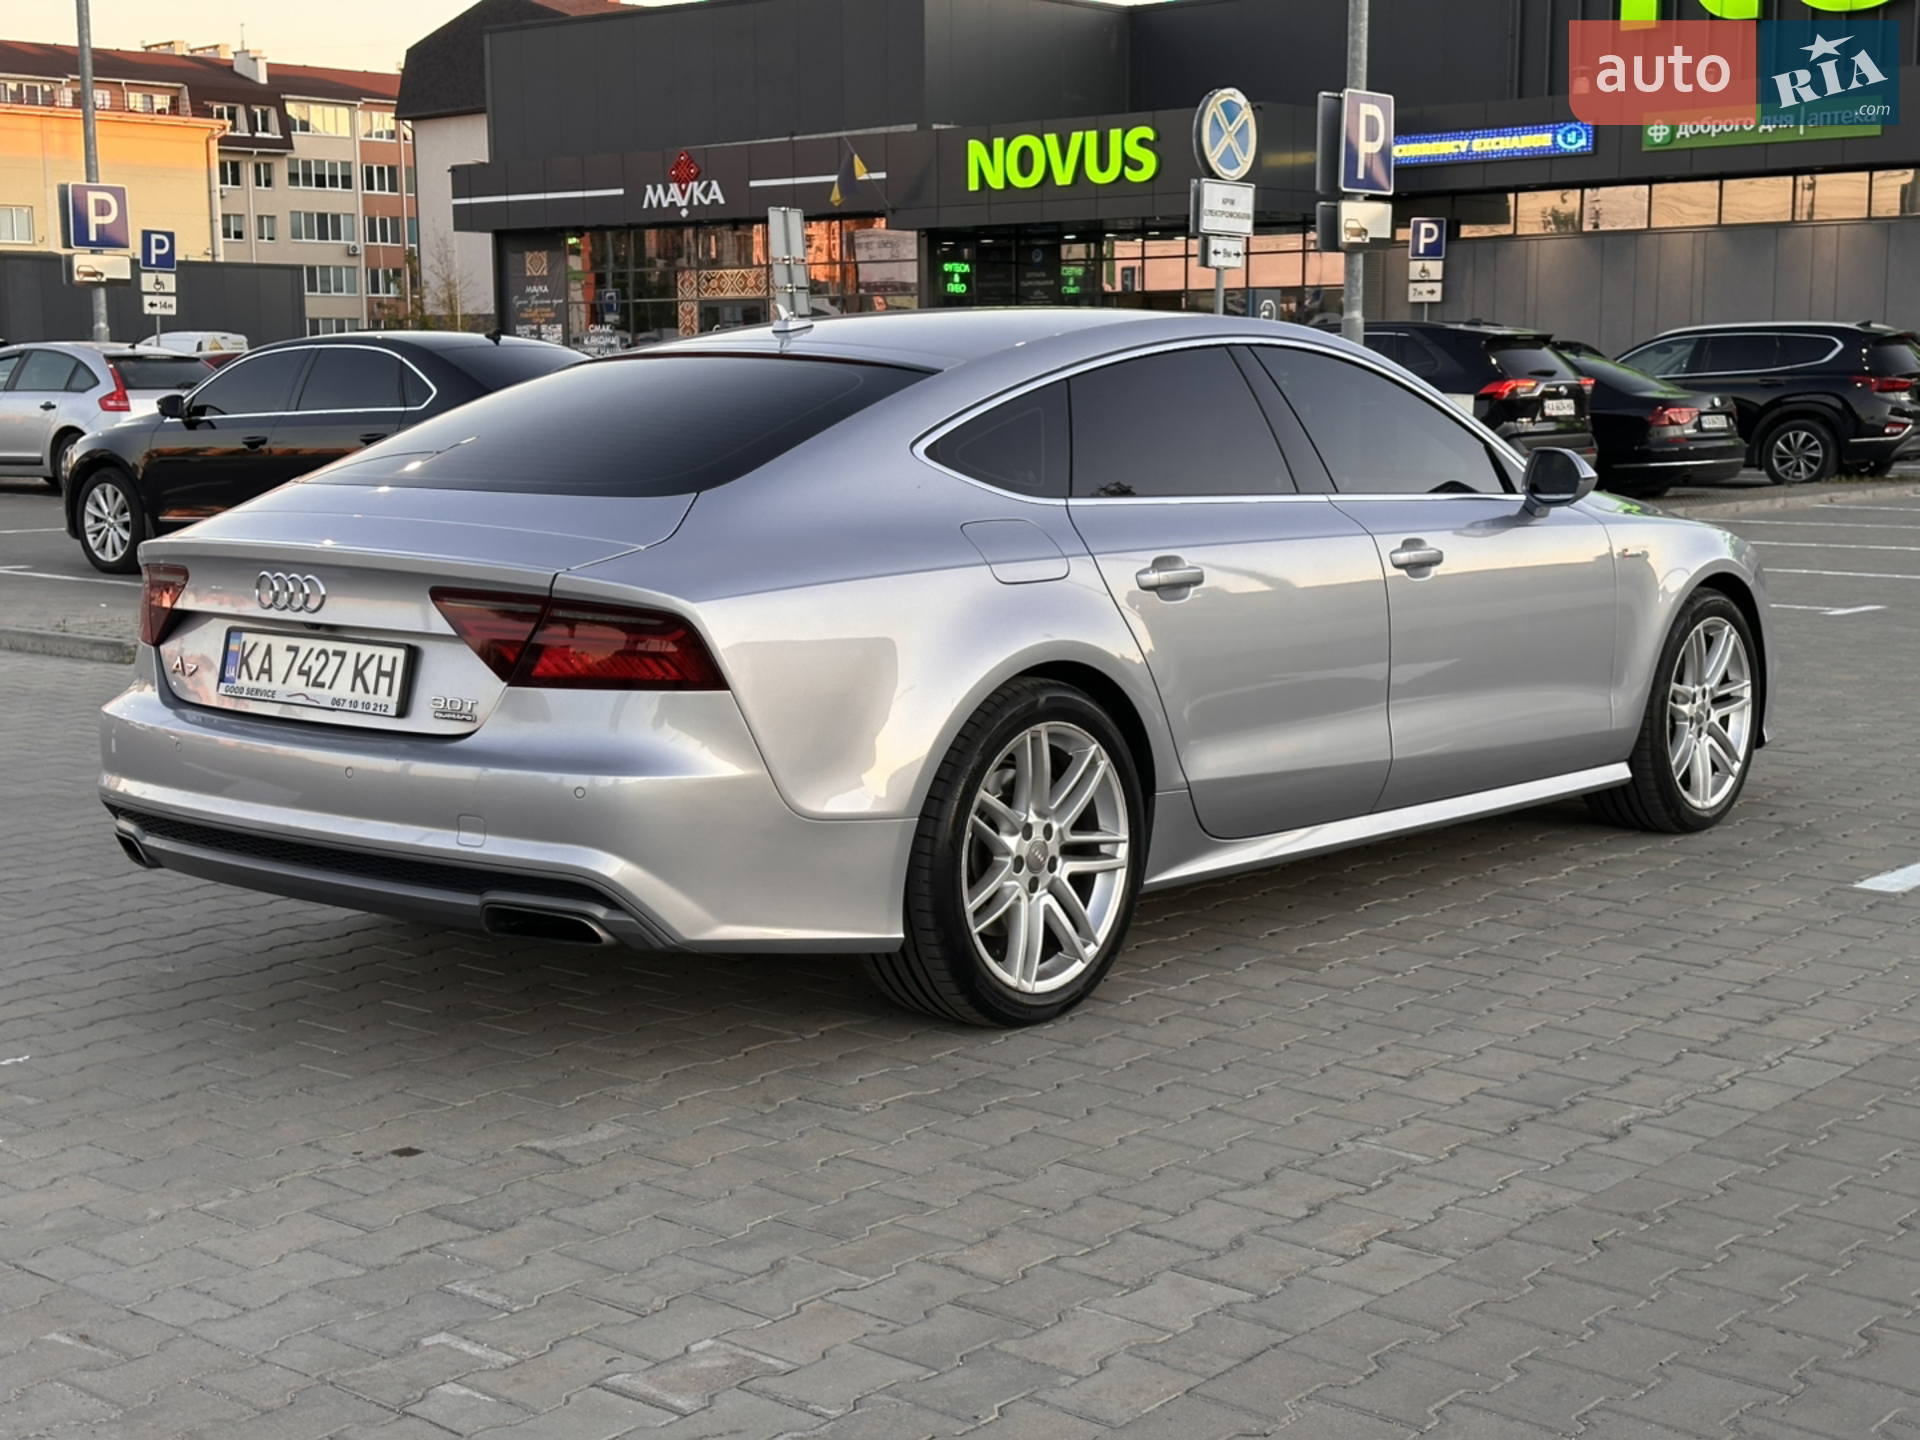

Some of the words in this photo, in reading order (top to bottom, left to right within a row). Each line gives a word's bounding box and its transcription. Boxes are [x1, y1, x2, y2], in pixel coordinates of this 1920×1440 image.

[1676, 117, 1755, 139] доброго
[1759, 113, 1795, 133] дня
[1808, 109, 1877, 127] аптека
[1357, 103, 1385, 179] P
[1472, 133, 1553, 151] EXCHANGE
[968, 126, 1157, 191] NOVUS
[87, 191, 118, 242] P
[151, 233, 169, 265] P
[1419, 222, 1439, 254] P
[172, 656, 199, 677] A7
[225, 666, 236, 677] UA
[237, 641, 273, 683] KA
[282, 645, 347, 690] 7427
[350, 652, 397, 697] KH
[224, 685, 244, 695] GOOD
[245, 687, 276, 699] SERVICE
[331, 697, 346, 708] 067
[348, 700, 358, 709] 10
[361, 702, 370, 710] 10
[372, 703, 389, 713] 212
[434, 711, 473, 721] quattro
